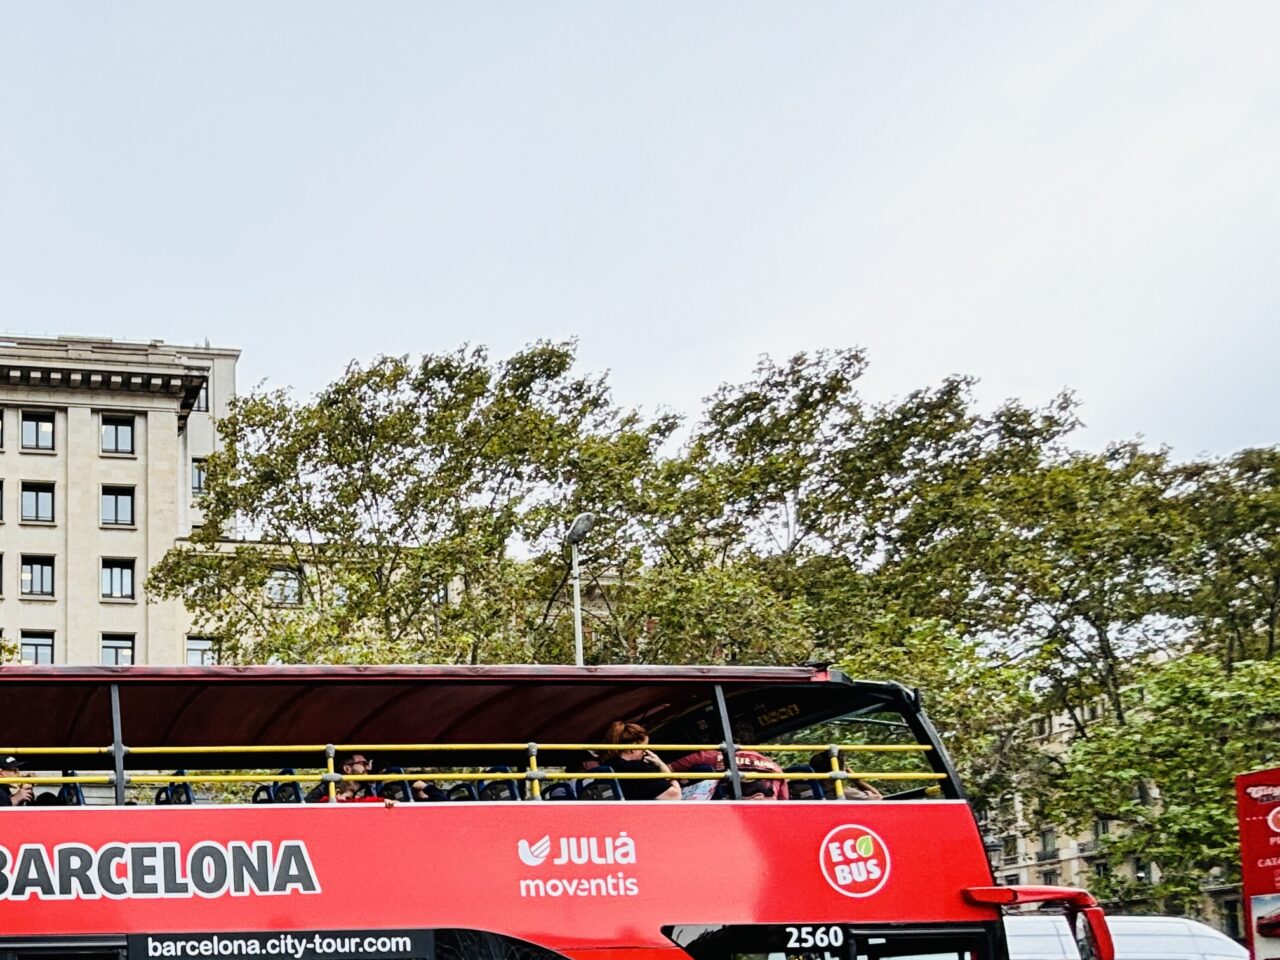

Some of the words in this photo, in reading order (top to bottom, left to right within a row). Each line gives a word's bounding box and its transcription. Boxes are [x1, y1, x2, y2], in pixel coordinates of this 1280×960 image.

[520, 871, 639, 897] moventis
[834, 859, 881, 885] BUS
[147, 935, 412, 959] barcelona.city-tour.com
[785, 926, 843, 948] 2560
